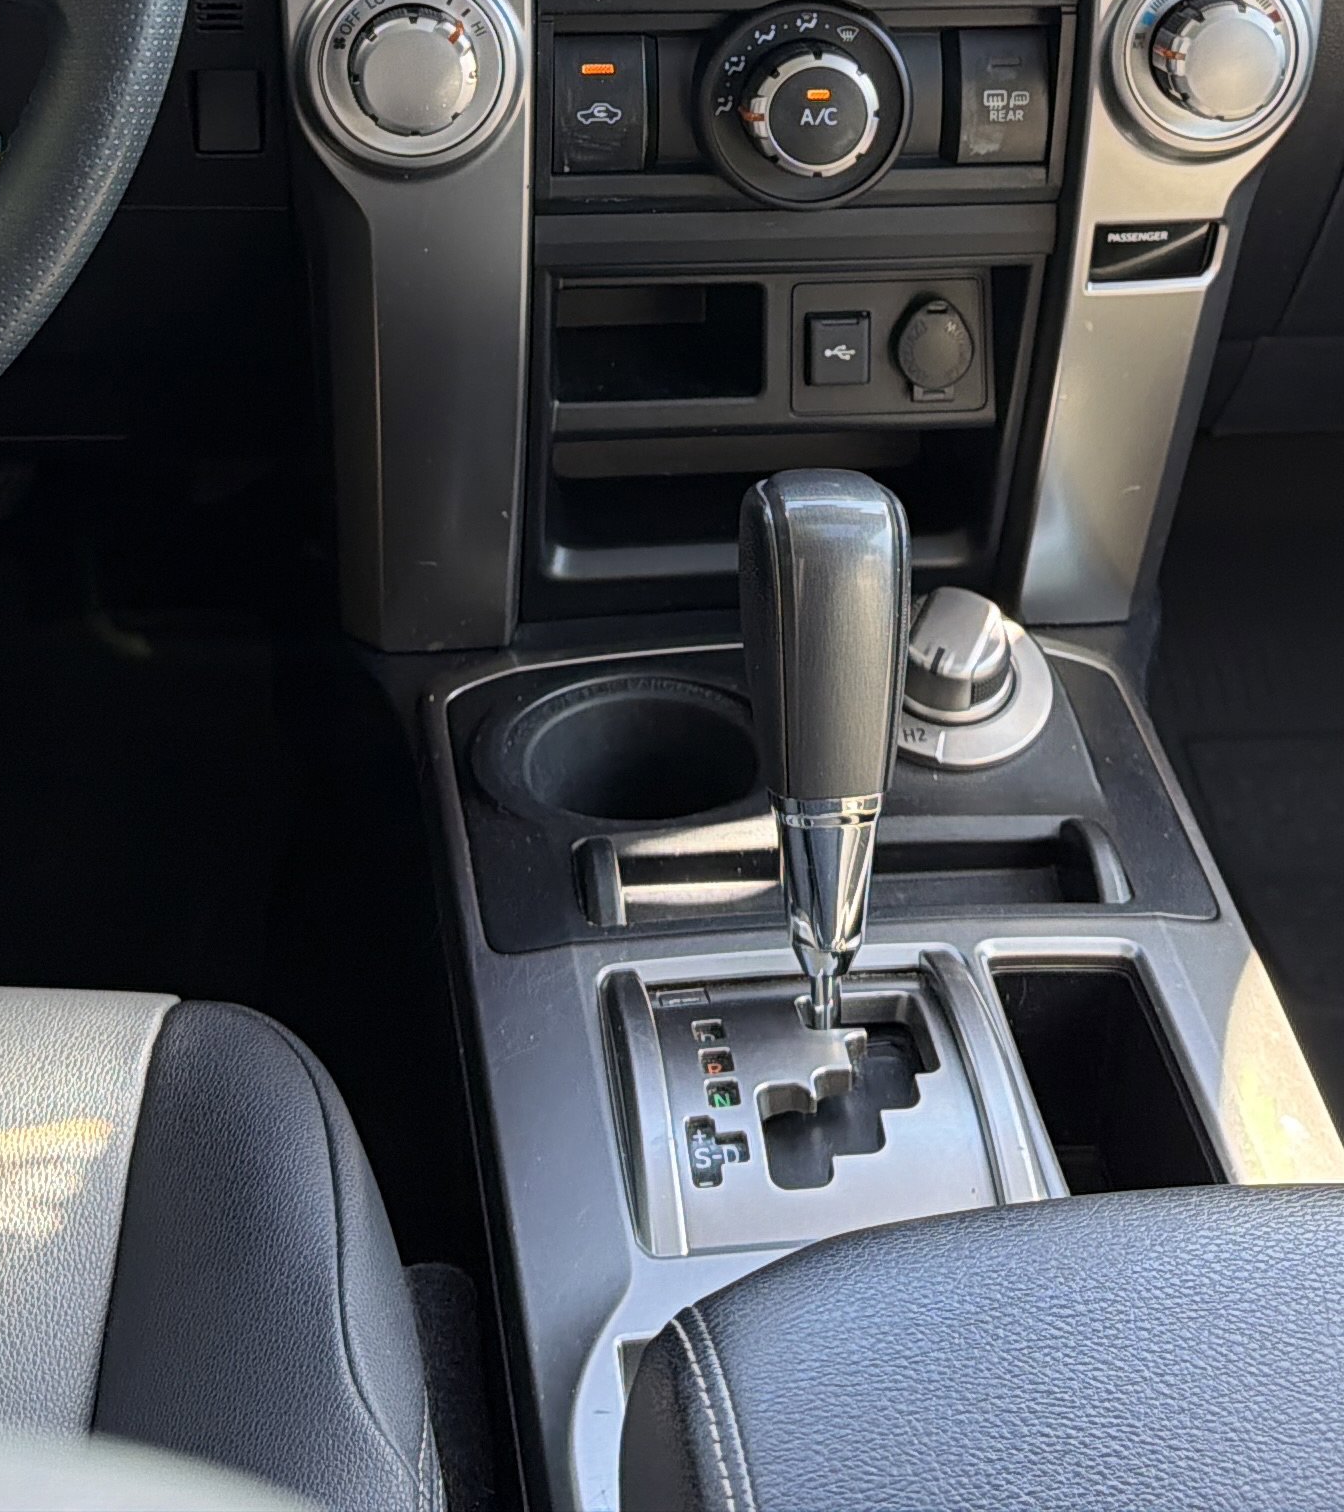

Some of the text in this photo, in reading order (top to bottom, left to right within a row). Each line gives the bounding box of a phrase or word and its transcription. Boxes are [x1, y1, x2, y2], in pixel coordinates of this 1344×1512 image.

[339, 9, 363, 35] OFF
[470, 20, 488, 38] HI
[800, 107, 838, 126] A/C
[989, 110, 1024, 122] REAR
[1106, 230, 1169, 243] PASSENGER
[903, 727, 927, 743] H2
